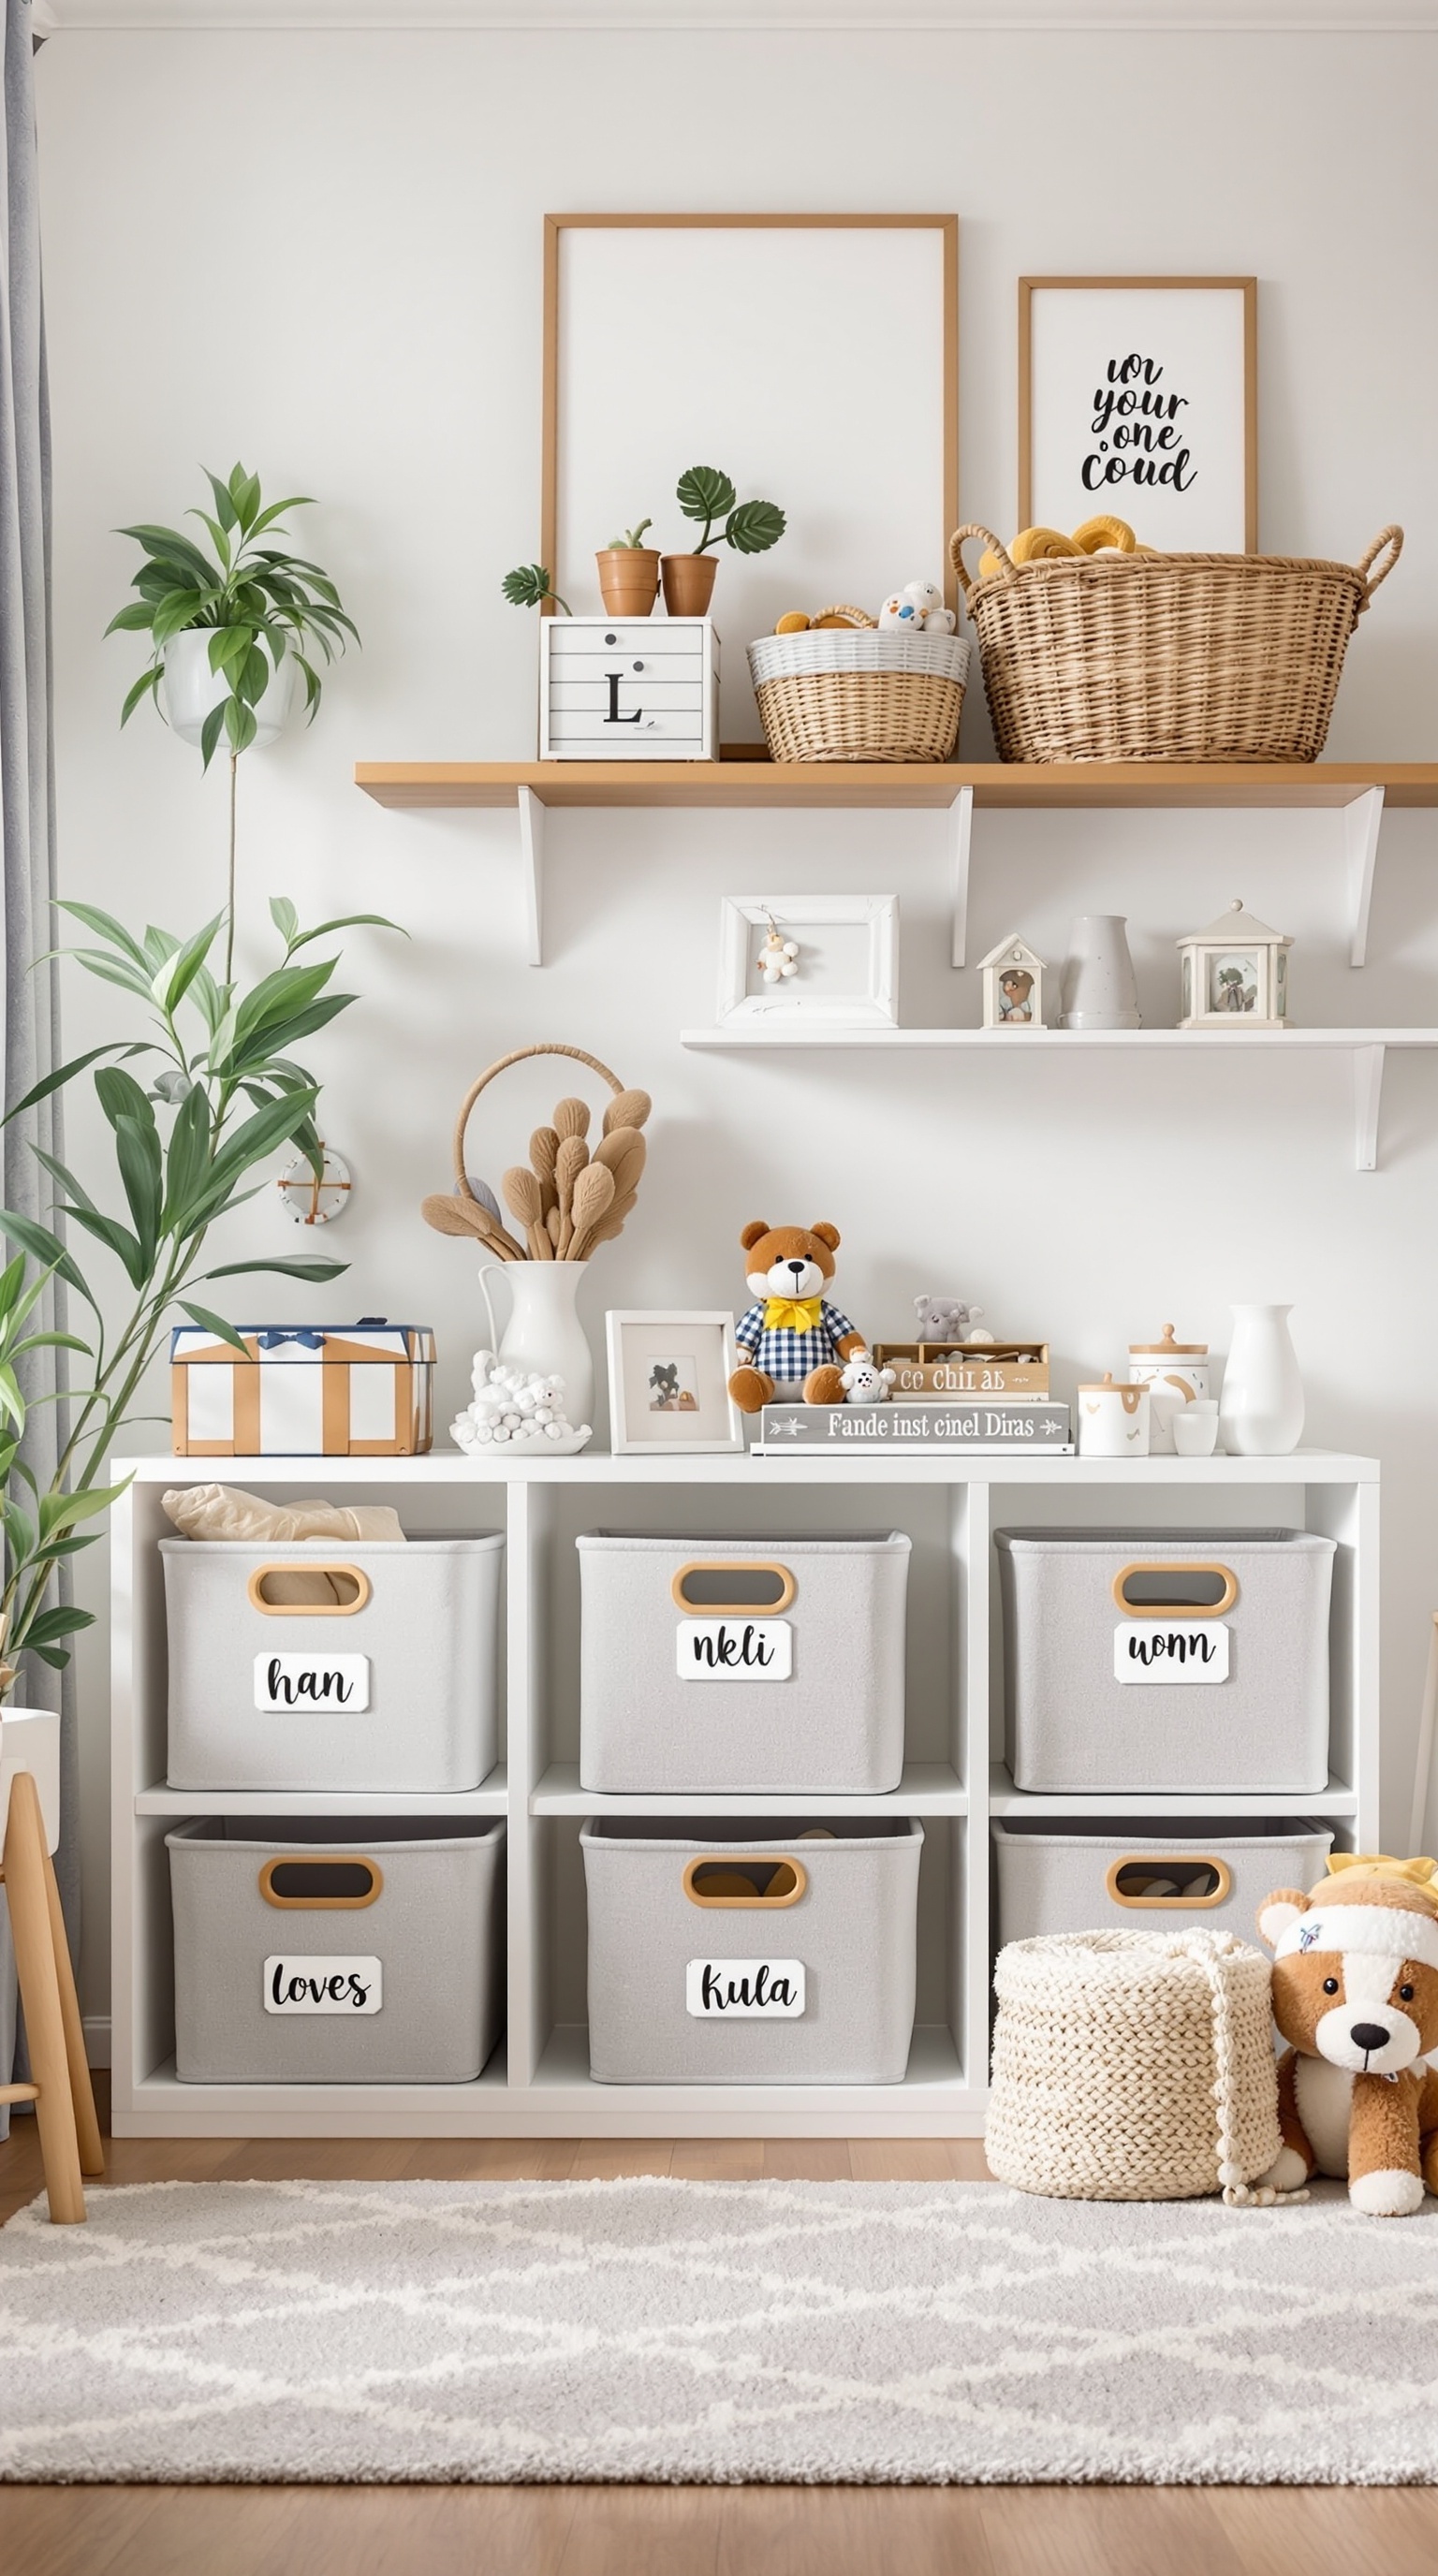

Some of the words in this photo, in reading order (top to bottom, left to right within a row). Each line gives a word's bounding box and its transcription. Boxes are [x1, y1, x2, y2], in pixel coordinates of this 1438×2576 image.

[1092, 389, 1190, 433] your
[604, 674, 642, 723] L
[828, 1412, 888, 1437] Fande
[892, 1412, 930, 1437] inst
[934, 1412, 980, 1437] cinel
[268, 1658, 354, 1705] han
[272, 1963, 372, 2007] loves
